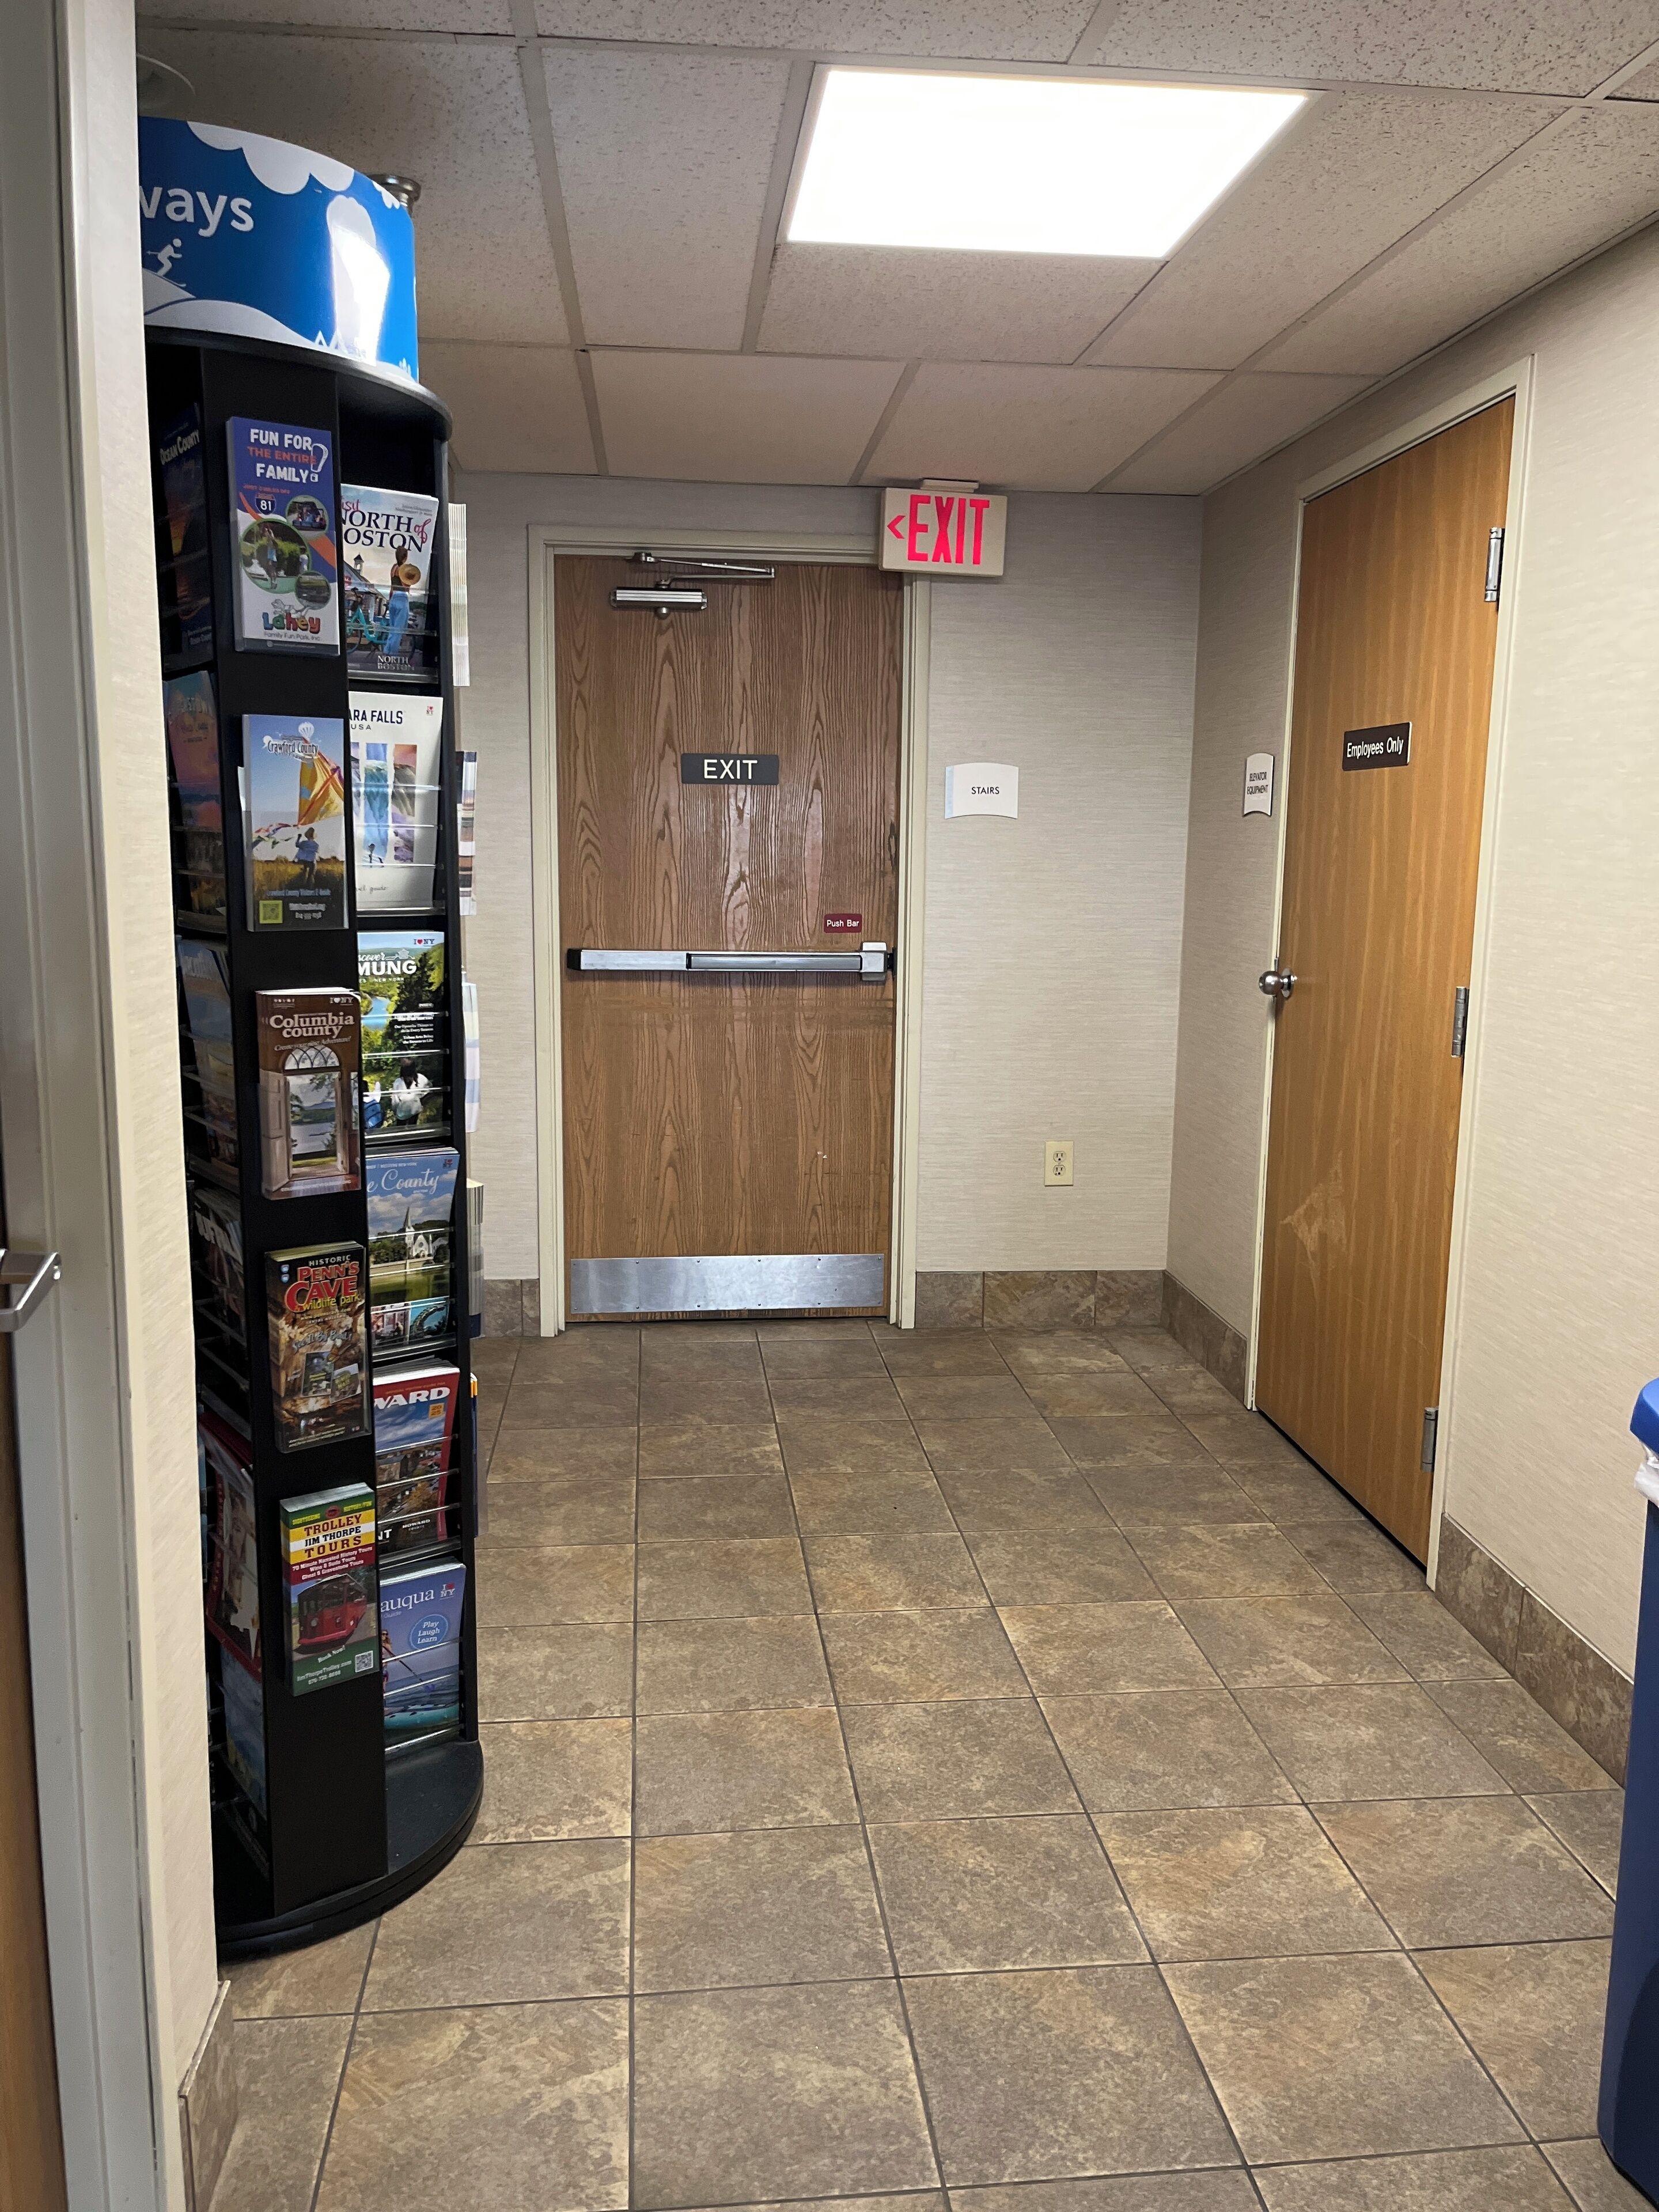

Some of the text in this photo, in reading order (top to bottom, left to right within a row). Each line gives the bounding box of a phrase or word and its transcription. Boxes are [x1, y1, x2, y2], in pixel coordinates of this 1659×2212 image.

[250, 429, 312, 451] FUN FOR
[247, 446, 317, 465] THE ENTIRE
[260, 500, 272, 511] 81
[414, 518, 431, 544] of
[907, 494, 990, 565] EXIT
[262, 612, 321, 634] Lahey
[378, 655, 408, 664] NORTH
[378, 662, 415, 671] BOSTON
[371, 710, 403, 725] FALLS
[268, 740, 296, 754] Crawford
[297, 742, 319, 757] County
[1347, 736, 1404, 759] Employees Only
[704, 759, 758, 779] EXIT
[1249, 772, 1267, 782] ELEVATOR
[971, 786, 999, 795] STAIRS
[1247, 785, 1268, 795] EQUIPMENT
[827, 919, 859, 927] Push Bar
[358, 960, 417, 976] MUNG
[270, 1012, 355, 1028] Columbia
[282, 1025, 343, 1039] county
[381, 1168, 440, 1195] County
[309, 1255, 351, 1267] HISTORIC
[297, 1262, 360, 1282] PENN'S
[285, 1275, 358, 1313] CAVE
[303, 1297, 336, 1311] wildlife
[374, 1387, 450, 1410] WARD
[304, 1514, 362, 1536] TROLLEY
[402, 1519, 430, 1528] HOWARD
[305, 1526, 361, 1547] JIM THORPE
[304, 1536, 362, 1558] TOURS
[340, 1550, 358, 1559] History
[440, 1588, 456, 1597] NY
[381, 1589, 435, 1613] auqua
[417, 1636, 437, 1644] Learn
[418, 1628, 440, 1637] Laugh
